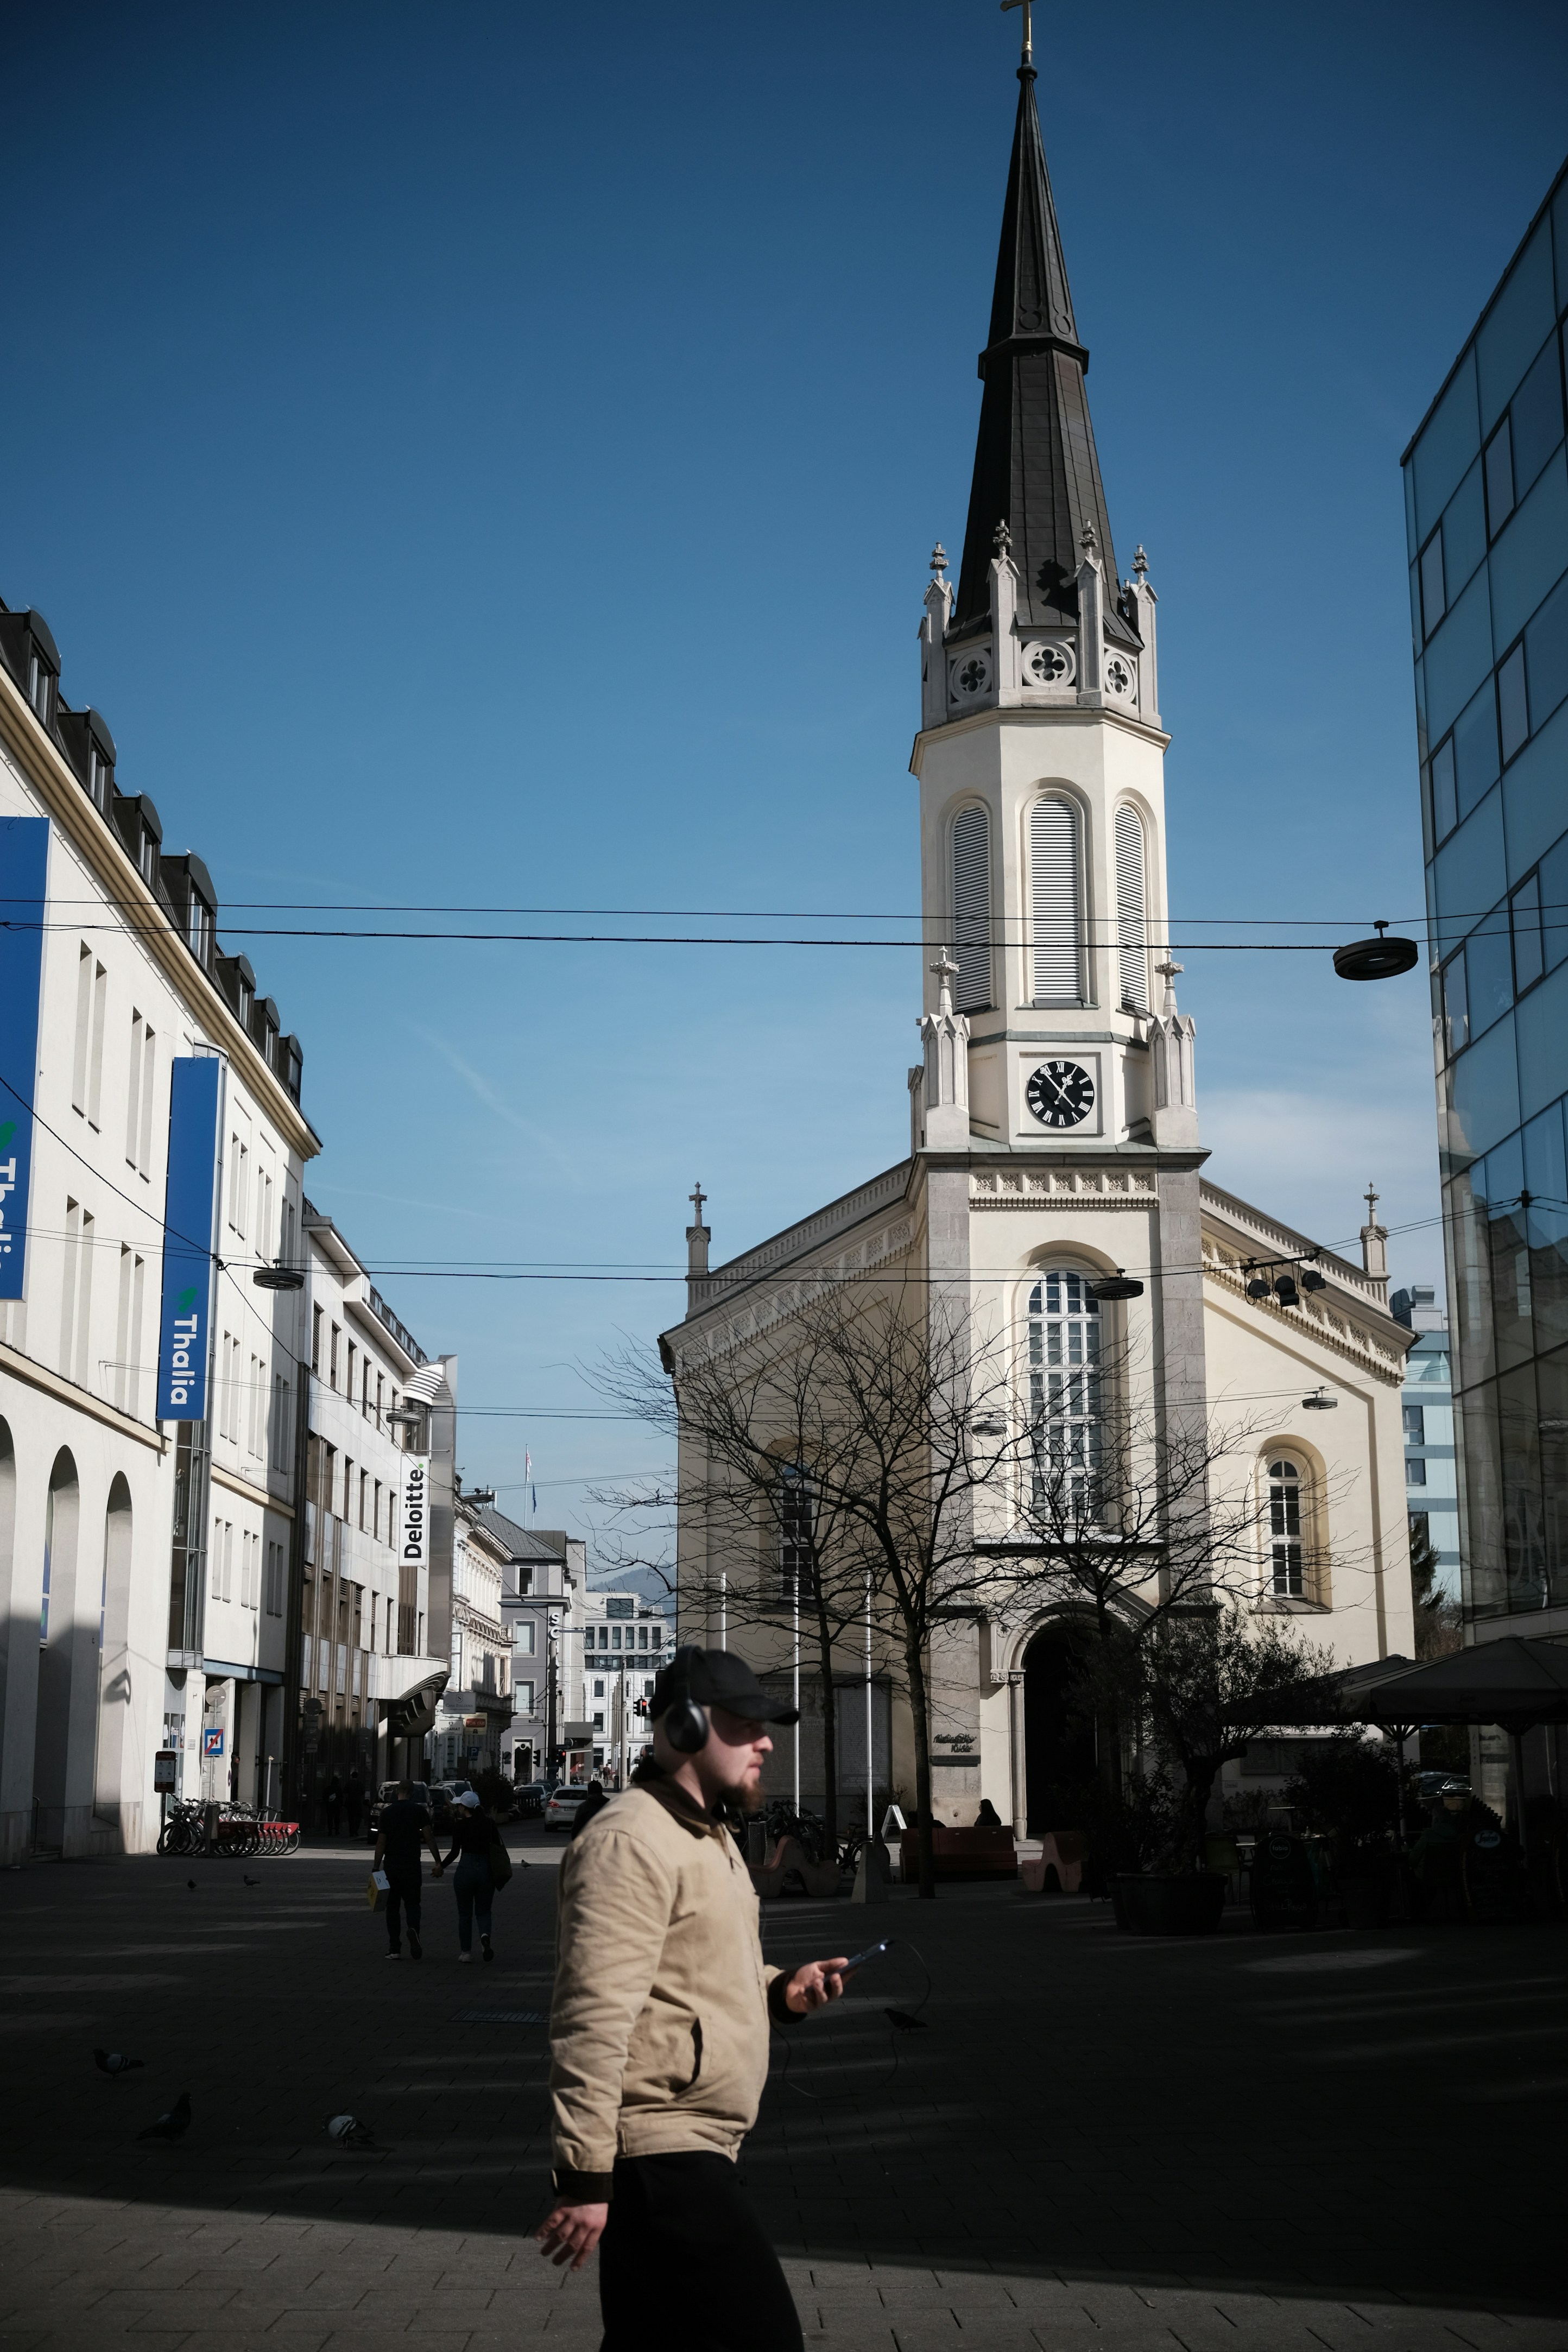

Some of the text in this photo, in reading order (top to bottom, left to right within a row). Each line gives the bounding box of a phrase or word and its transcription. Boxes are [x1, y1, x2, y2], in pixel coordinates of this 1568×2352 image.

[1056, 1062, 1065, 1073] XII
[1032, 1076, 1043, 1085] X
[1078, 1076, 1090, 1085] II
[1030, 1101, 1045, 1114] VIII
[1042, 1110, 1053, 1123] VII
[1058, 1114, 1066, 1126] VI
[1071, 1111, 1080, 1122] V
[171, 1314, 197, 1404] Thalia
